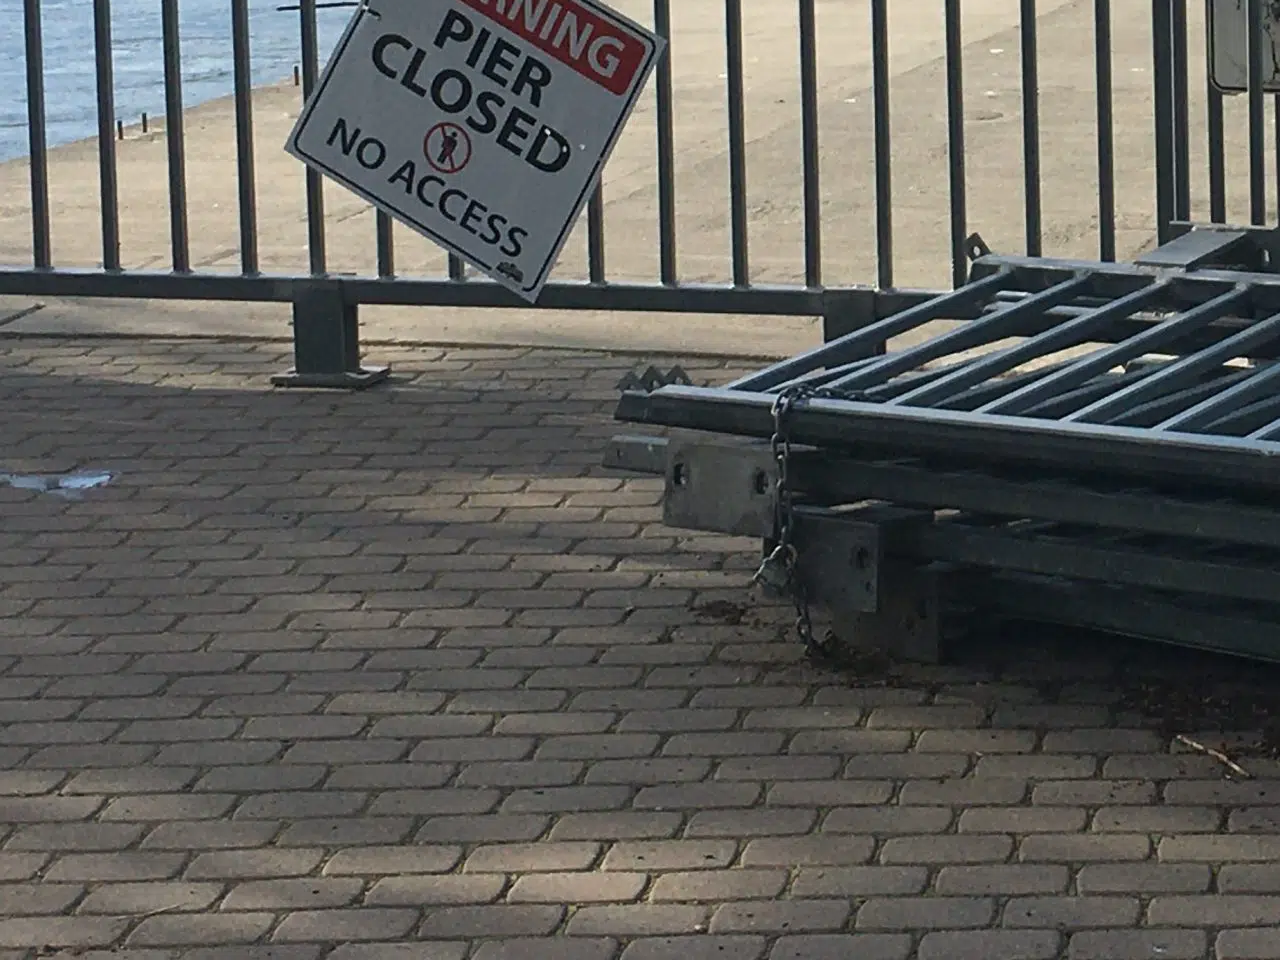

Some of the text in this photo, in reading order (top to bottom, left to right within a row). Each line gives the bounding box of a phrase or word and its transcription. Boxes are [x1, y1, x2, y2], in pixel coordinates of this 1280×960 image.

[371, 33, 572, 173] CLOSED
[433, 9, 553, 107] PIER
[326, 117, 529, 258] NO ACCESS
